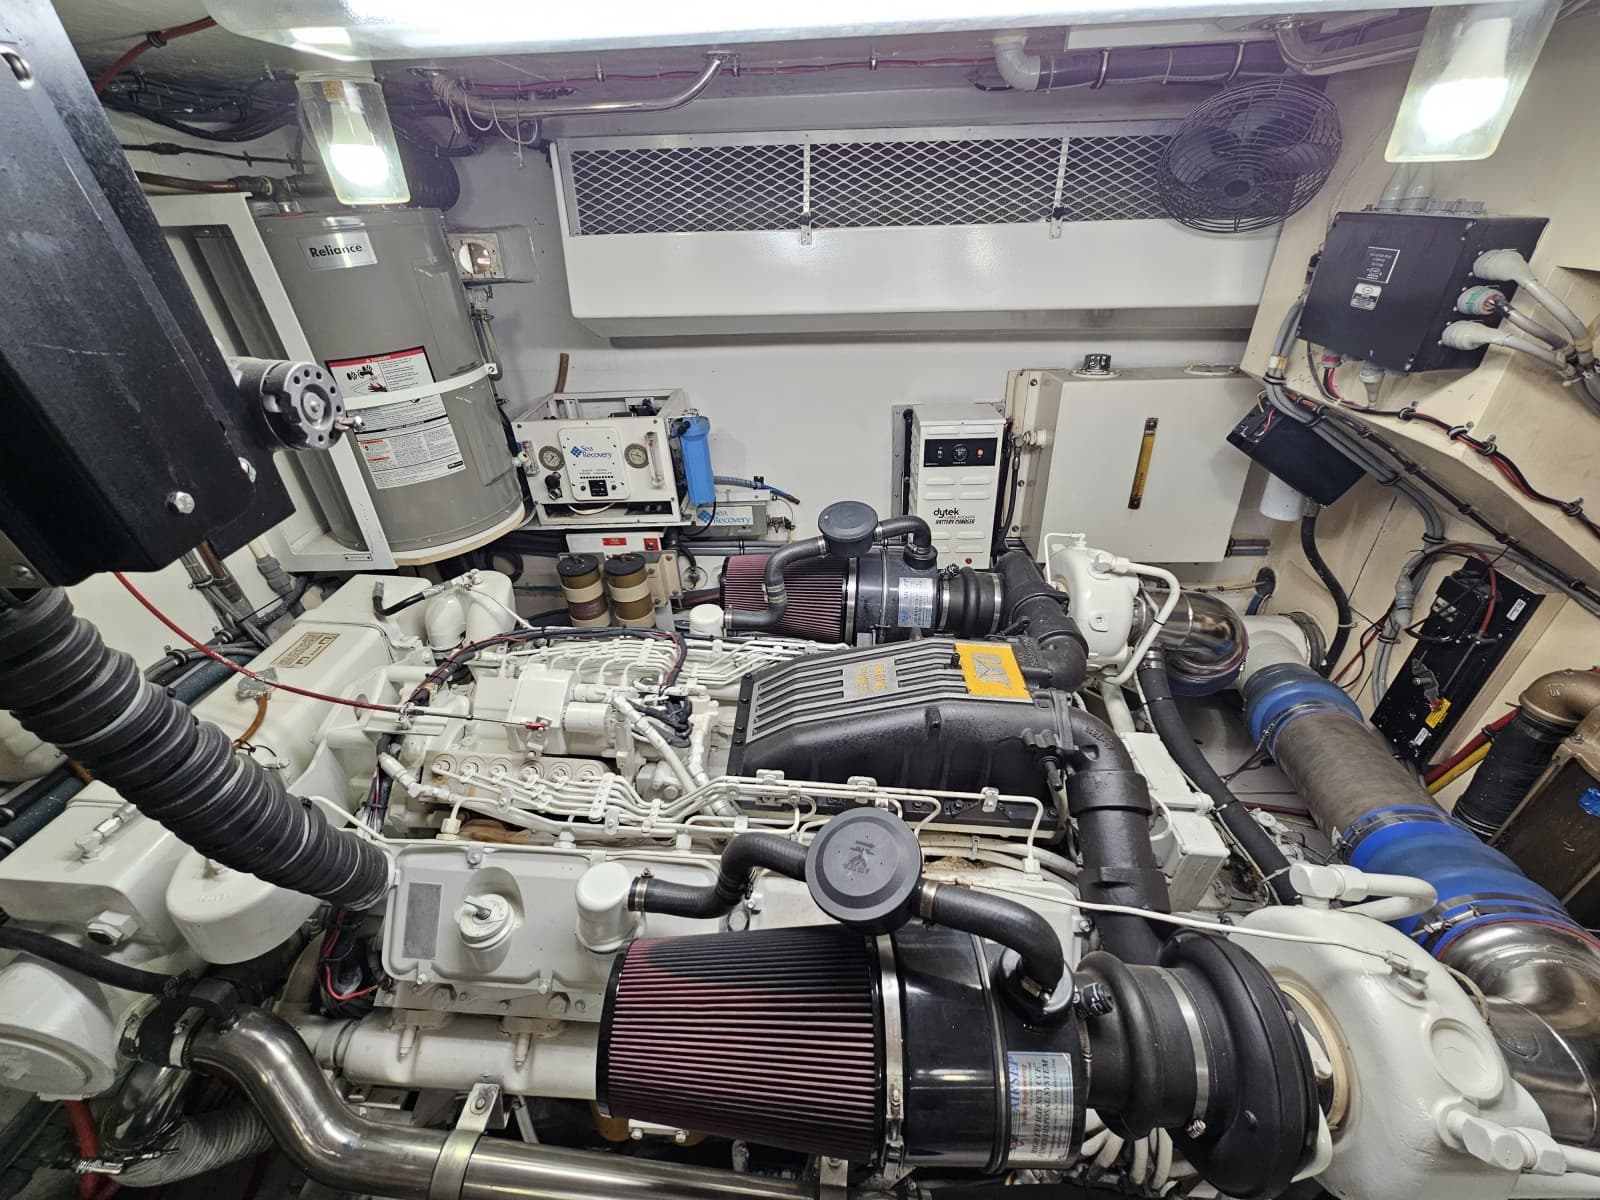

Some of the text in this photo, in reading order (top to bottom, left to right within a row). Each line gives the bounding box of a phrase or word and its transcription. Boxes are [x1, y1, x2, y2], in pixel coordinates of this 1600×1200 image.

[309, 244, 363, 258] Reliance
[582, 451, 612, 460] Recovery
[933, 508, 959, 518] dytek
[1041, 1059, 1050, 1097] SYSTEM
